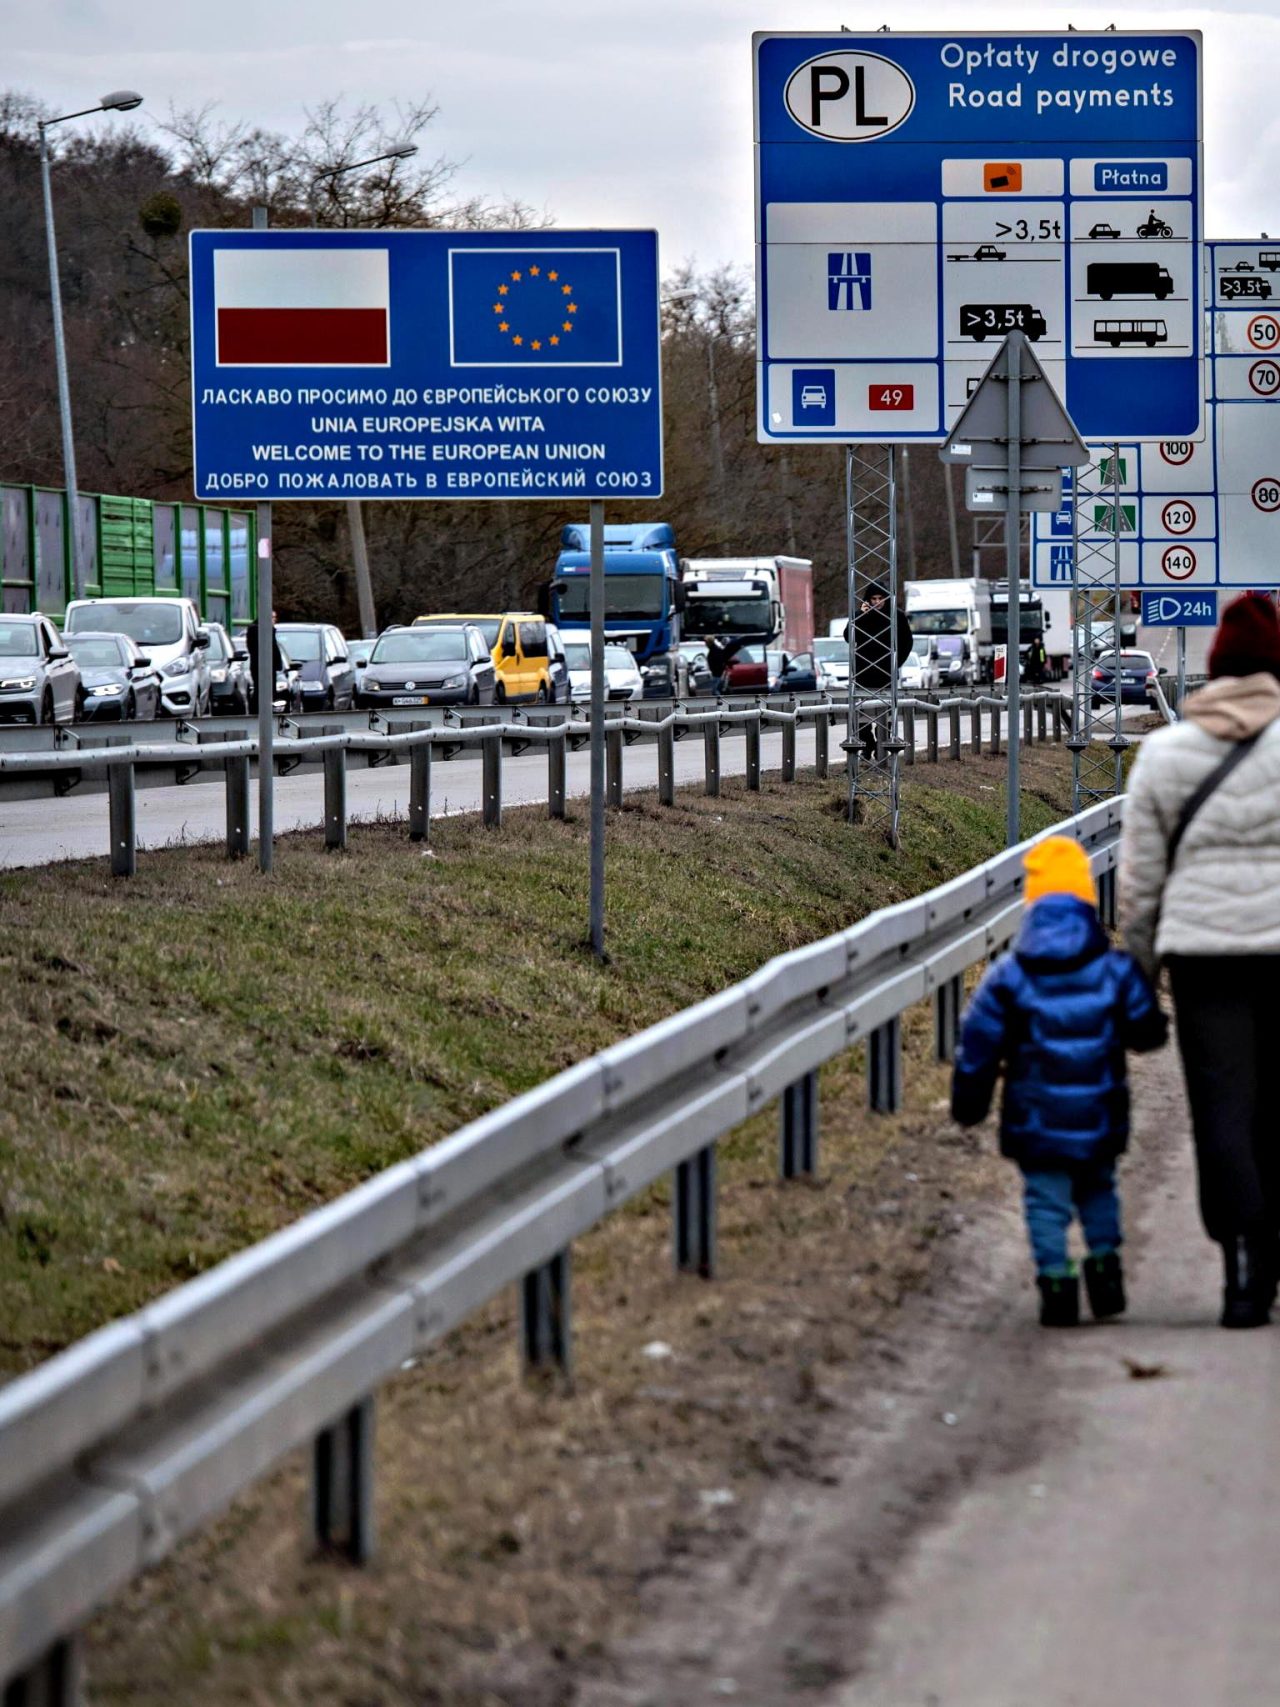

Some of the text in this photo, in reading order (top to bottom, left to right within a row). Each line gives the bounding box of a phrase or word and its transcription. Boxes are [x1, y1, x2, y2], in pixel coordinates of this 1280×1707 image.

[941, 43, 1176, 75] Opłaty drogowe
[811, 66, 888, 126] PL
[950, 83, 1173, 114] Road payments
[1103, 169, 1160, 184] Płatna
[995, 220, 1061, 242] >3,5t
[967, 309, 1024, 329] >3,5t
[1253, 323, 1276, 341] 50
[1256, 370, 1276, 386] 70
[202, 385, 651, 405] ЛАСКАВО ПРОСИМО ДО ЄВРОПЕЙСЬКОГО СОЮЗУ
[881, 390, 902, 405] 49
[312, 416, 544, 432] UNIA EUROPEJSKA WITA
[252, 444, 605, 460] WELCOME TO THE EUROPEAN UNION
[1165, 442, 1189, 455] 100
[206, 469, 651, 490] ДОБРО ПОЖАЛОВАТЬ В ЕВРОПЕЙСКИЙ СОЮЗ
[1258, 487, 1279, 503] 80
[1166, 510, 1191, 525] 120
[1166, 556, 1191, 570] 140
[1183, 601, 1212, 617] 24h
